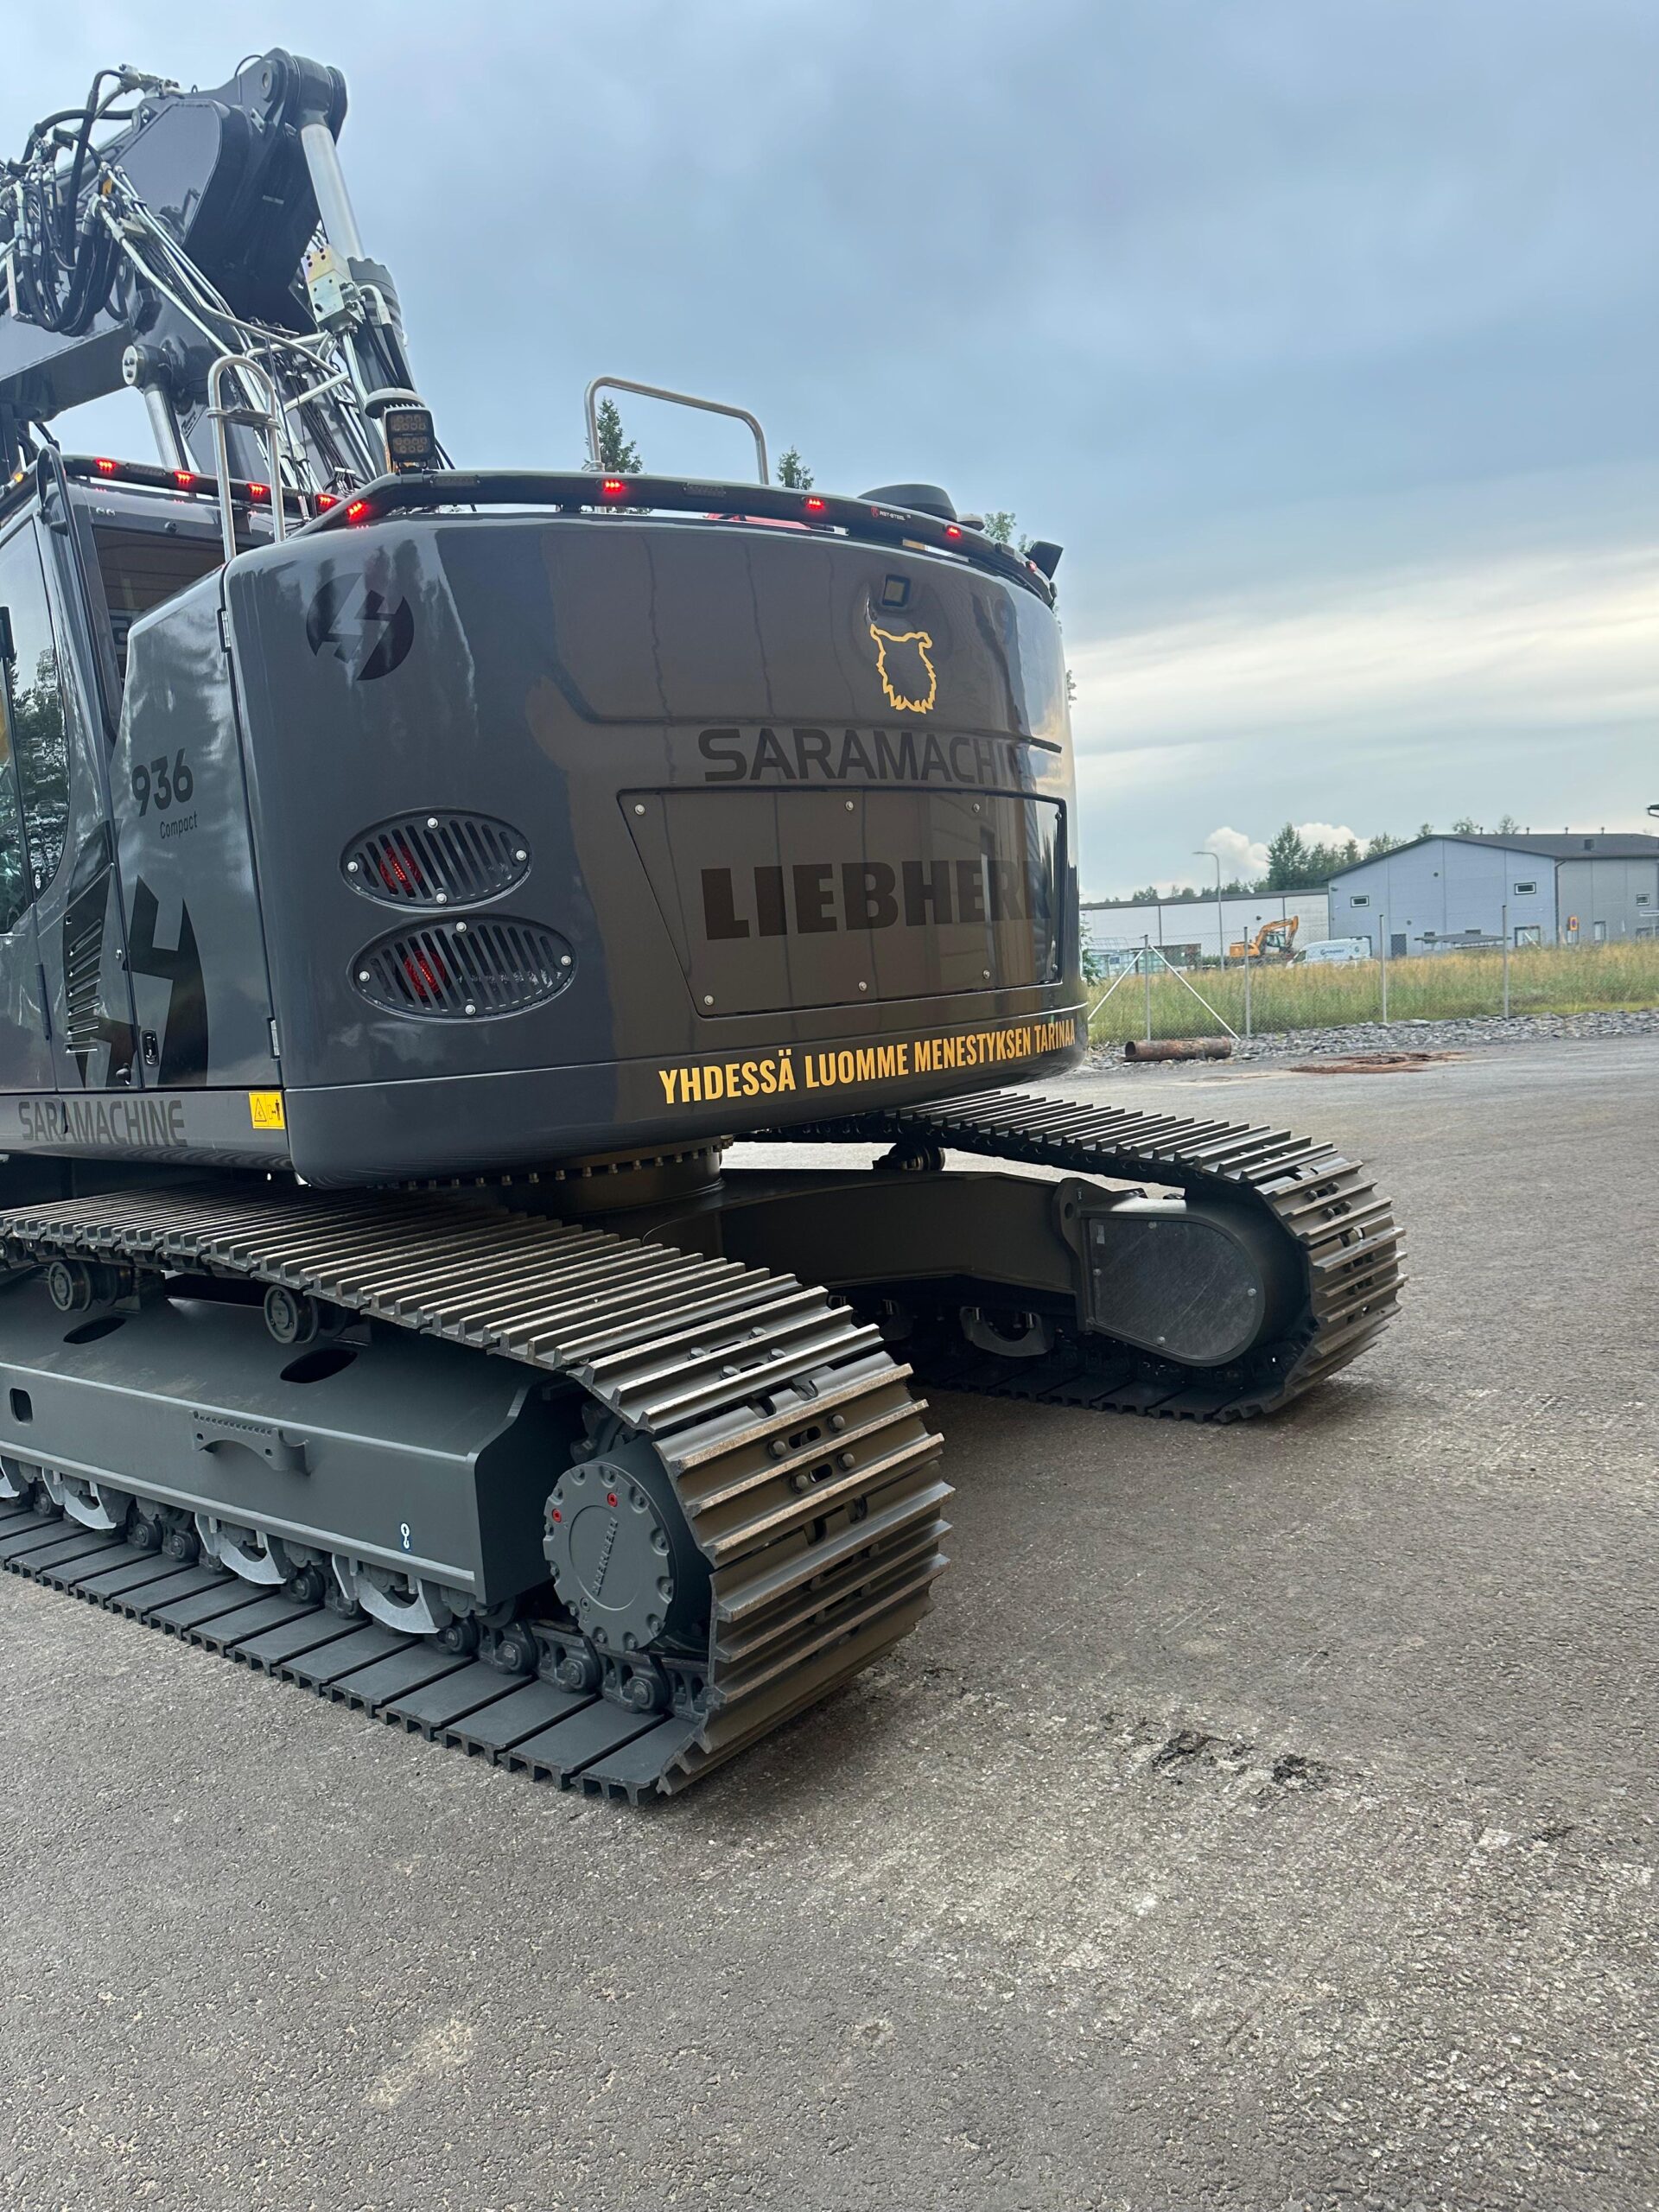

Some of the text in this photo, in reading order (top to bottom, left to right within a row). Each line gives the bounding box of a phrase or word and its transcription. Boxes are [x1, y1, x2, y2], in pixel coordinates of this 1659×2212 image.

[131, 748, 194, 817] 936
[697, 728, 1037, 788] SARAMACHI
[159, 810, 198, 840] Compact
[701, 859, 1052, 940] LIEBHERR
[659, 1019, 1076, 1104] YHDESSÄ LUOMME MENESTYKSEN TARINAA
[18, 1100, 188, 1147] SARAMACHINE
